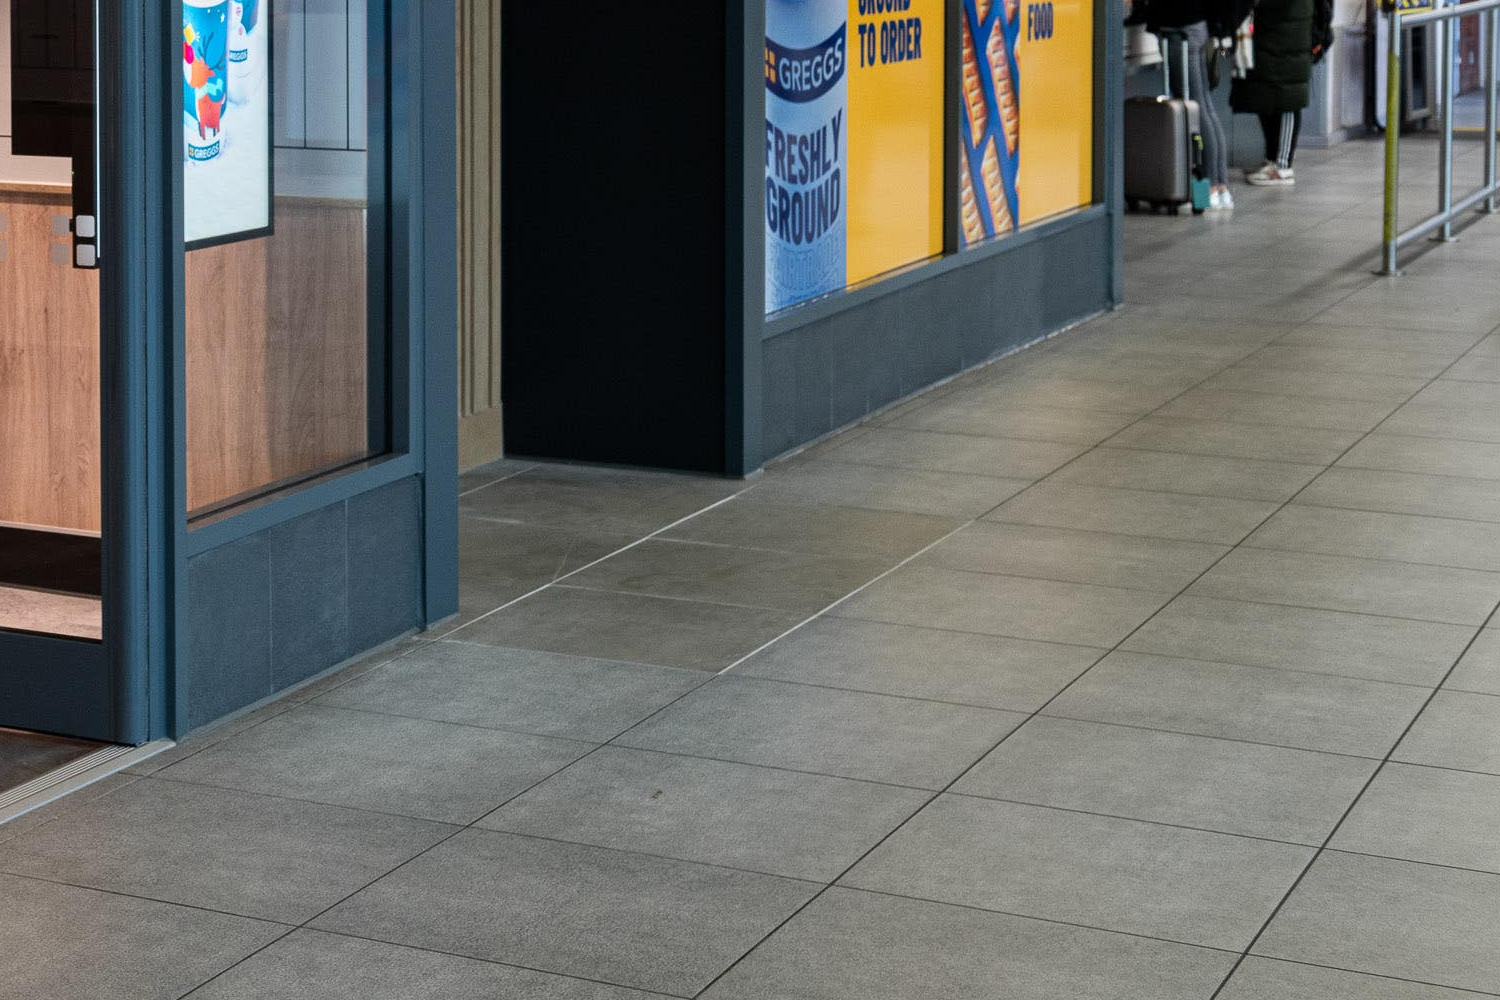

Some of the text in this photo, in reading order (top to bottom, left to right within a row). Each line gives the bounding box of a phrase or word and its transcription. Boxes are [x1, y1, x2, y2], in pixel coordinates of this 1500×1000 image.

[858, 17, 922, 68] TO ORDER
[1028, 2, 1053, 42] FOOD
[779, 37, 842, 91] GREGGS
[766, 107, 842, 186] FRESHLY
[766, 168, 840, 245] GROUND
